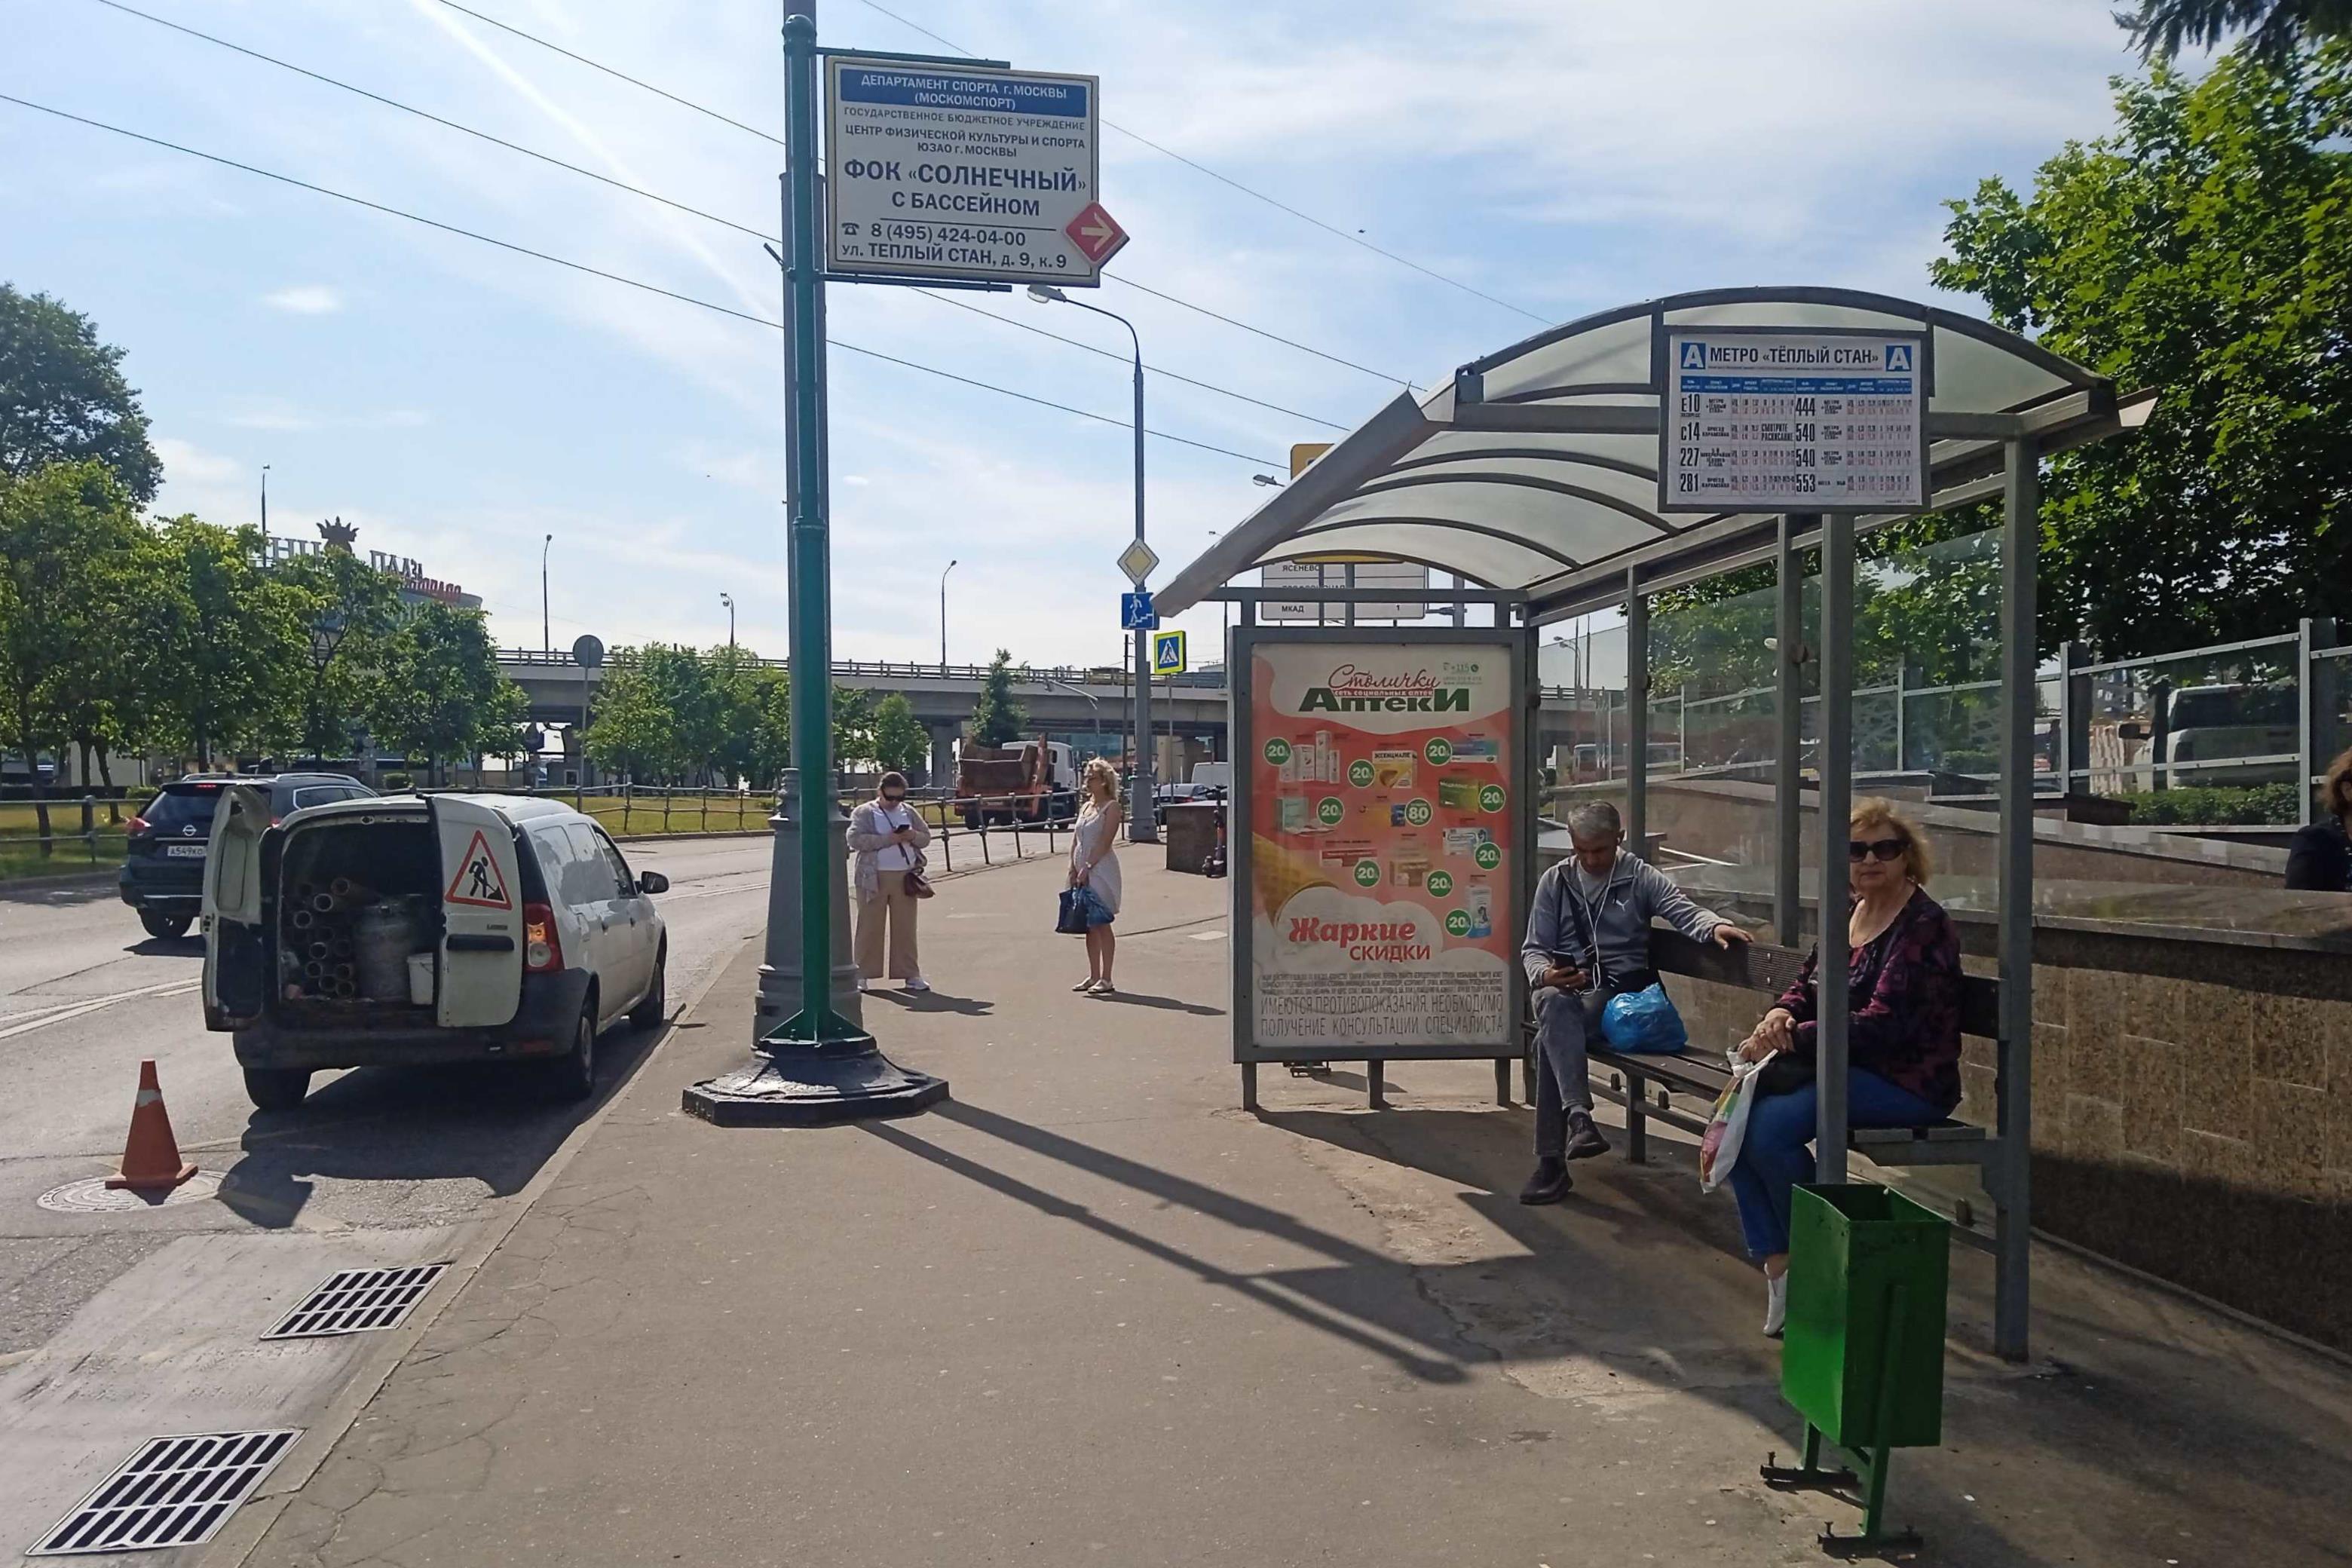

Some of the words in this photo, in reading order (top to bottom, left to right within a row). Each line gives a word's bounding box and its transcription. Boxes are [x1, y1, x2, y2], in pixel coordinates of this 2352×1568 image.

[861, 75, 948, 90] ДЕПАРТАМЕНТ
[952, 81, 998, 94] СПОРТА
[1013, 86, 1067, 99] МОСКВЫ
[915, 92, 1015, 111] (МОСКОМСПОРТ)
[844, 107, 944, 121] ГОСУДАРСТВЕННОЕ
[948, 114, 1013, 126] БЮДЖЕТНОЕ
[1017, 118, 1085, 130] УЧРЕЖДЕНИЕ
[845, 124, 882, 136] ЦЕНТР
[885, 127, 966, 141] ФИЗИЧЕСКОЙ
[969, 132, 1028, 145] КУЛЬТУРЫ
[1031, 136, 1039, 145] И
[1042, 136, 1085, 149] СПОРТА
[917, 142, 951, 153] ЮЗАО
[965, 145, 1016, 157] МОСКВЫ
[844, 159, 901, 181] ФОК
[909, 164, 1086, 191] «СОЛНЕЧНЫЙ»
[892, 191, 905, 207] С
[911, 192, 1040, 216] БАССЕЙНОМ
[871, 223, 881, 237] 8
[887, 224, 933, 243] (495)
[938, 228, 1025, 246] 424-04-00
[841, 245, 864, 256] ул.
[868, 243, 942, 261] ТЕПЛЫЙ
[948, 248, 996, 266] СТАН,
[1001, 255, 1015, 266] д.
[1019, 252, 1034, 269] 9,
[1040, 256, 1052, 268] к.
[1056, 254, 1067, 268] 9
[1683, 344, 1704, 368] А
[1710, 347, 1758, 363] МЕТРО
[1762, 345, 1830, 363] «ТЁПЛЫЙ
[1834, 349, 1879, 363] СТАН»
[1888, 347, 1909, 370] А
[1795, 397, 1815, 416] 444
[1796, 423, 1815, 442] 540
[1680, 447, 1700, 467] 227
[1796, 449, 1815, 467] 540
[1680, 473, 1699, 492] 281
[1796, 473, 1815, 492] 553
[1328, 663, 1441, 688] Столички
[1408, 807, 1429, 819] 80
[1289, 917, 1416, 948] Жаркие
[1261, 996, 1312, 1015] ИМЕЮТСЯ
[1432, 994, 1503, 1013] НЕОБХОДИМО
[1261, 1018, 1326, 1037] ПОЛУЧЕНИЕ
[1333, 1017, 1419, 1036] КОНСУЛЬТАЦИИ
[1426, 1015, 1503, 1034] СПЕЦИАЛИСТА
